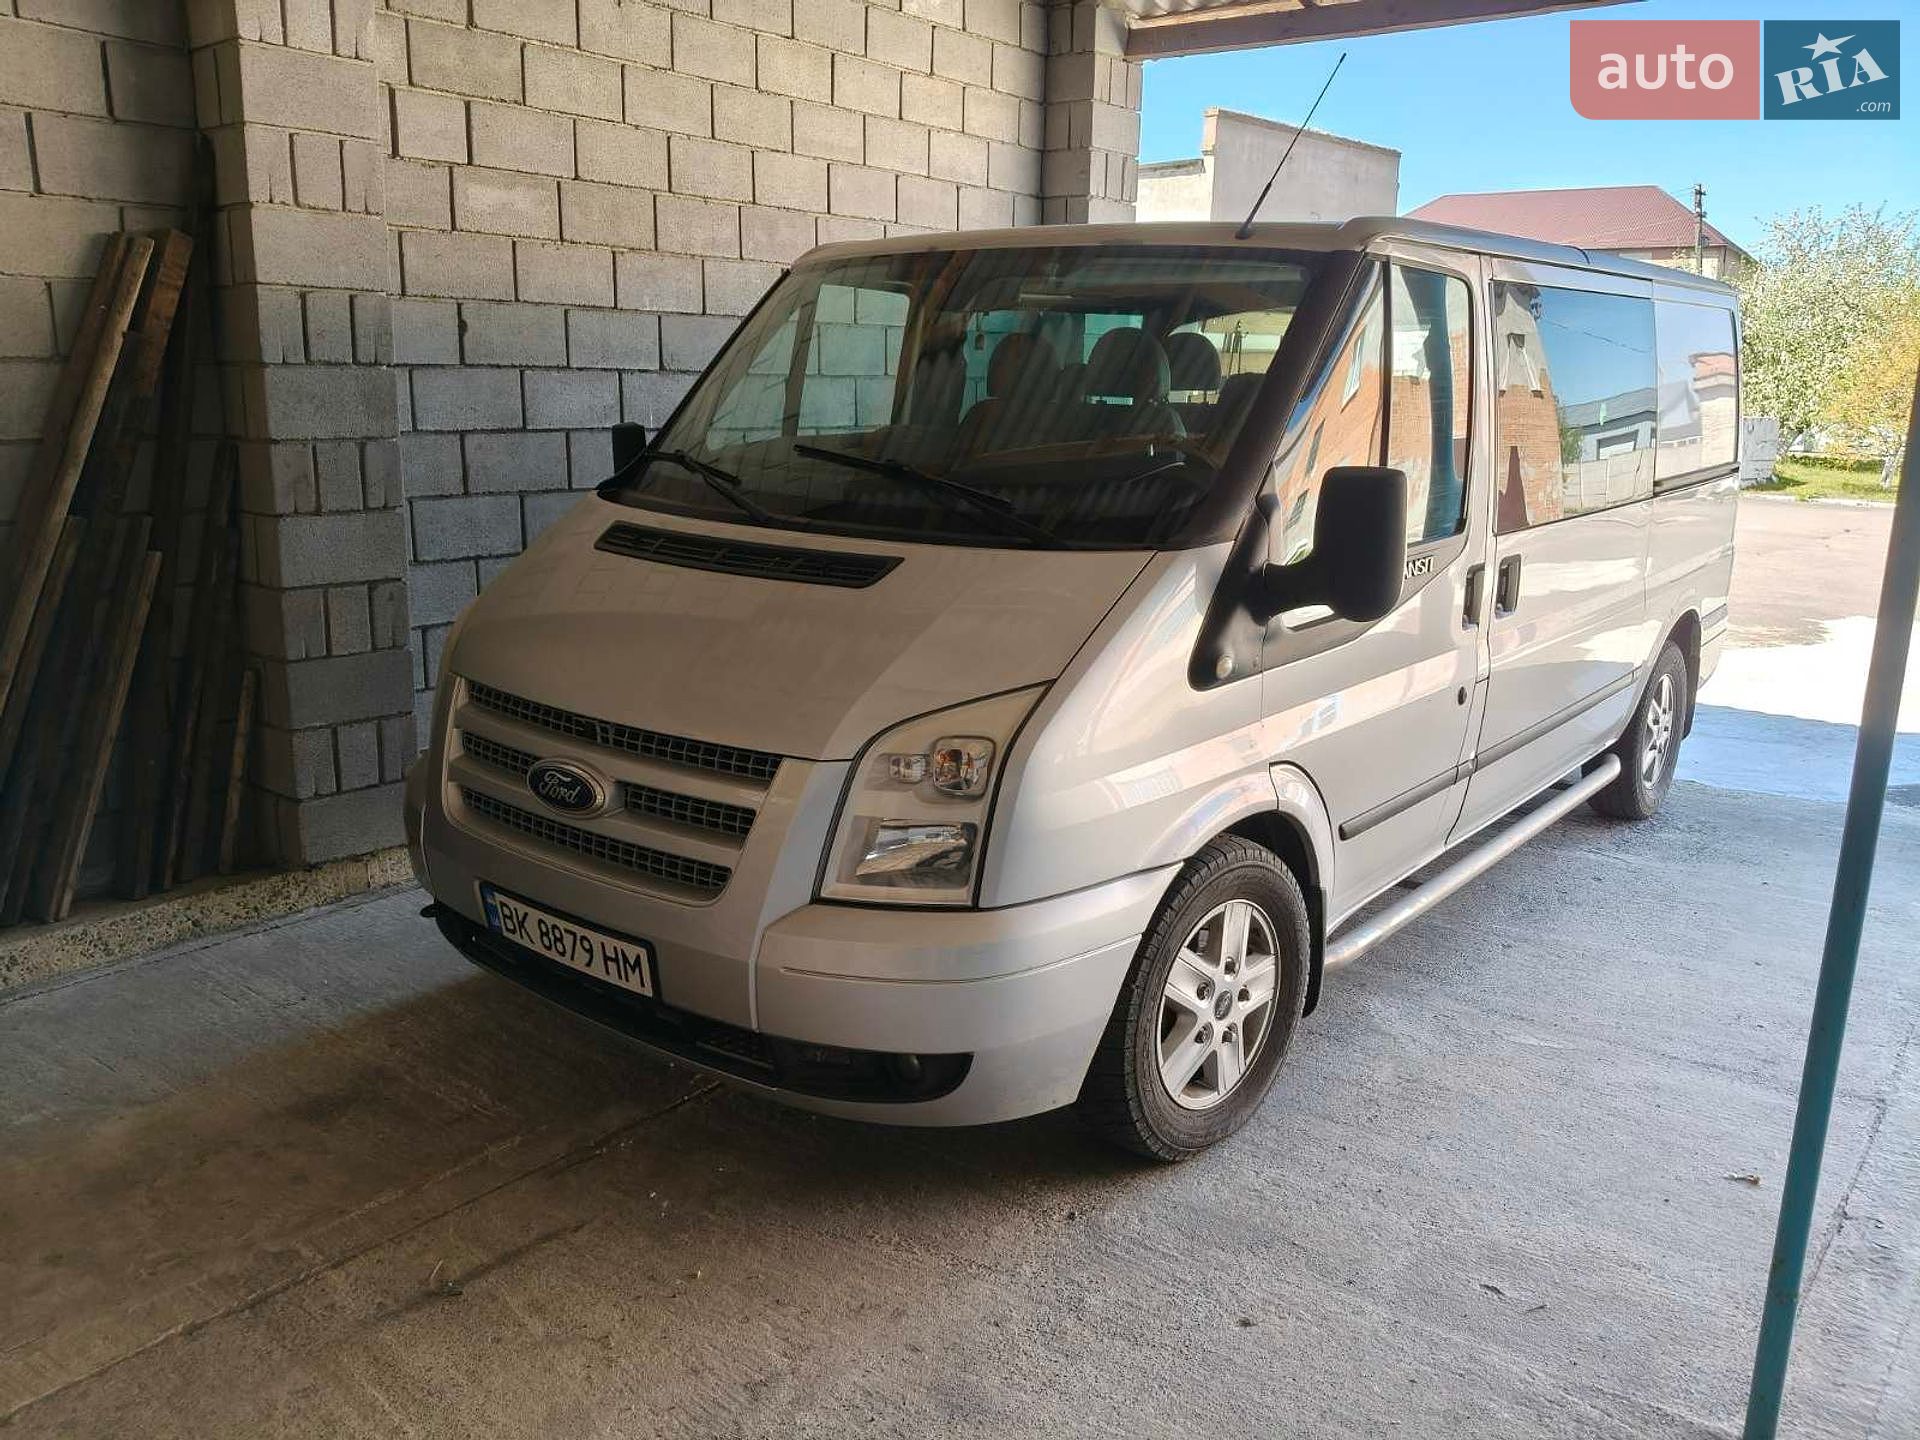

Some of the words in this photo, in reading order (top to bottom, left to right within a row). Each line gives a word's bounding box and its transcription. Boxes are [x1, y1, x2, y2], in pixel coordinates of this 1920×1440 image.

[540, 771, 581, 804] Ford
[500, 903, 535, 944] BK
[538, 918, 594, 967] 8879
[601, 941, 645, 988] HM
